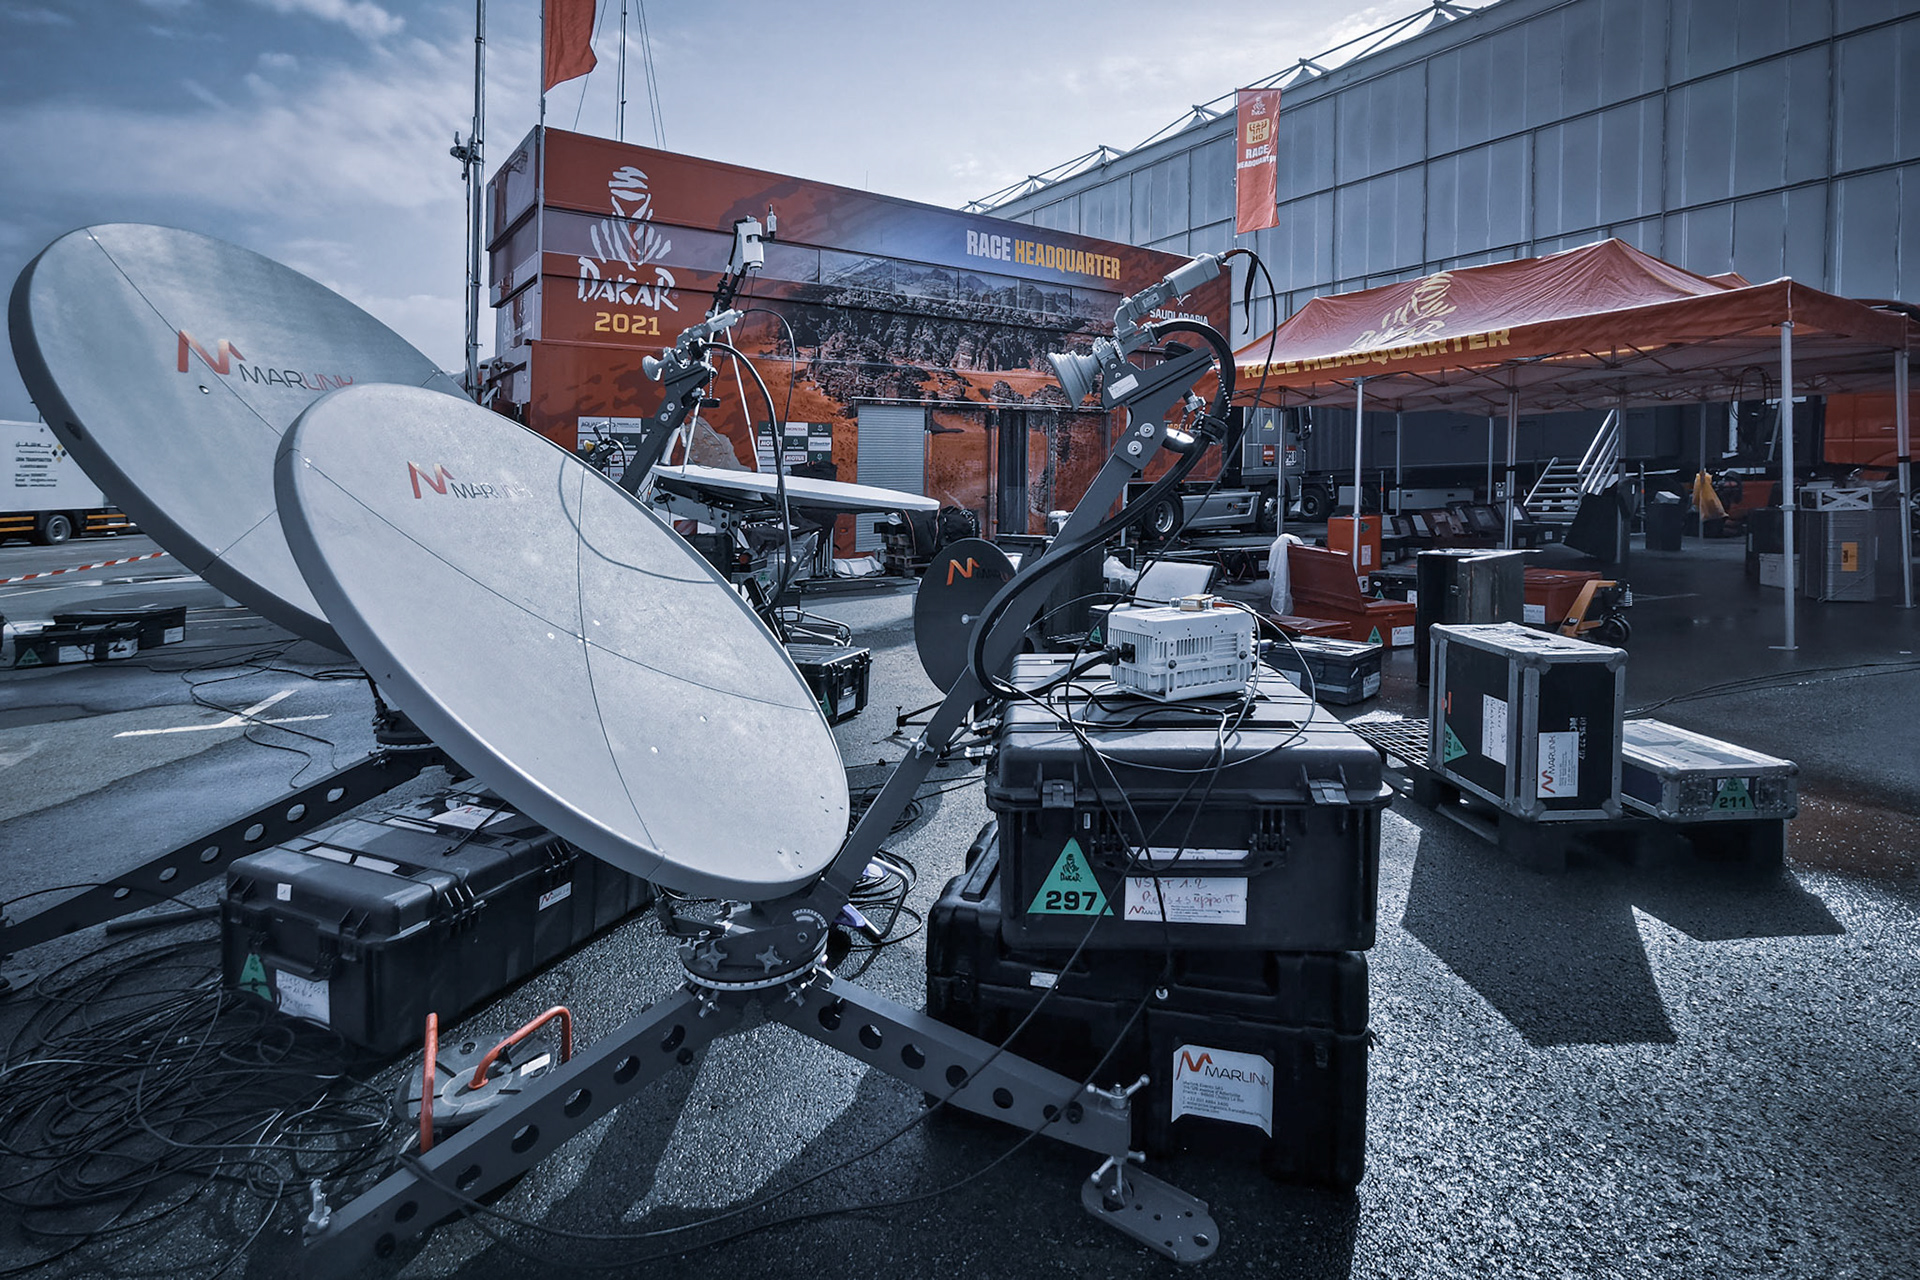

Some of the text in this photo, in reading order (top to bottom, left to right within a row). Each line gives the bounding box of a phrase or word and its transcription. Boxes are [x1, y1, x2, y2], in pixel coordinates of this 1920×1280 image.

[1245, 144, 1270, 159] RACE
[966, 229, 1121, 280] RACE HEADQUARTER
[578, 256, 679, 311] DAKAR
[595, 312, 660, 335] 2021
[1150, 308, 1174, 319] SAUDI
[1243, 328, 1511, 378] RACE HEADQUARTER
[1548, 735, 1556, 774] MARLINK
[1719, 796, 1746, 808] 211
[1060, 872, 1083, 882] DAKAR
[1045, 890, 1097, 911] 297
[1204, 1065, 1270, 1092] MARLINK
